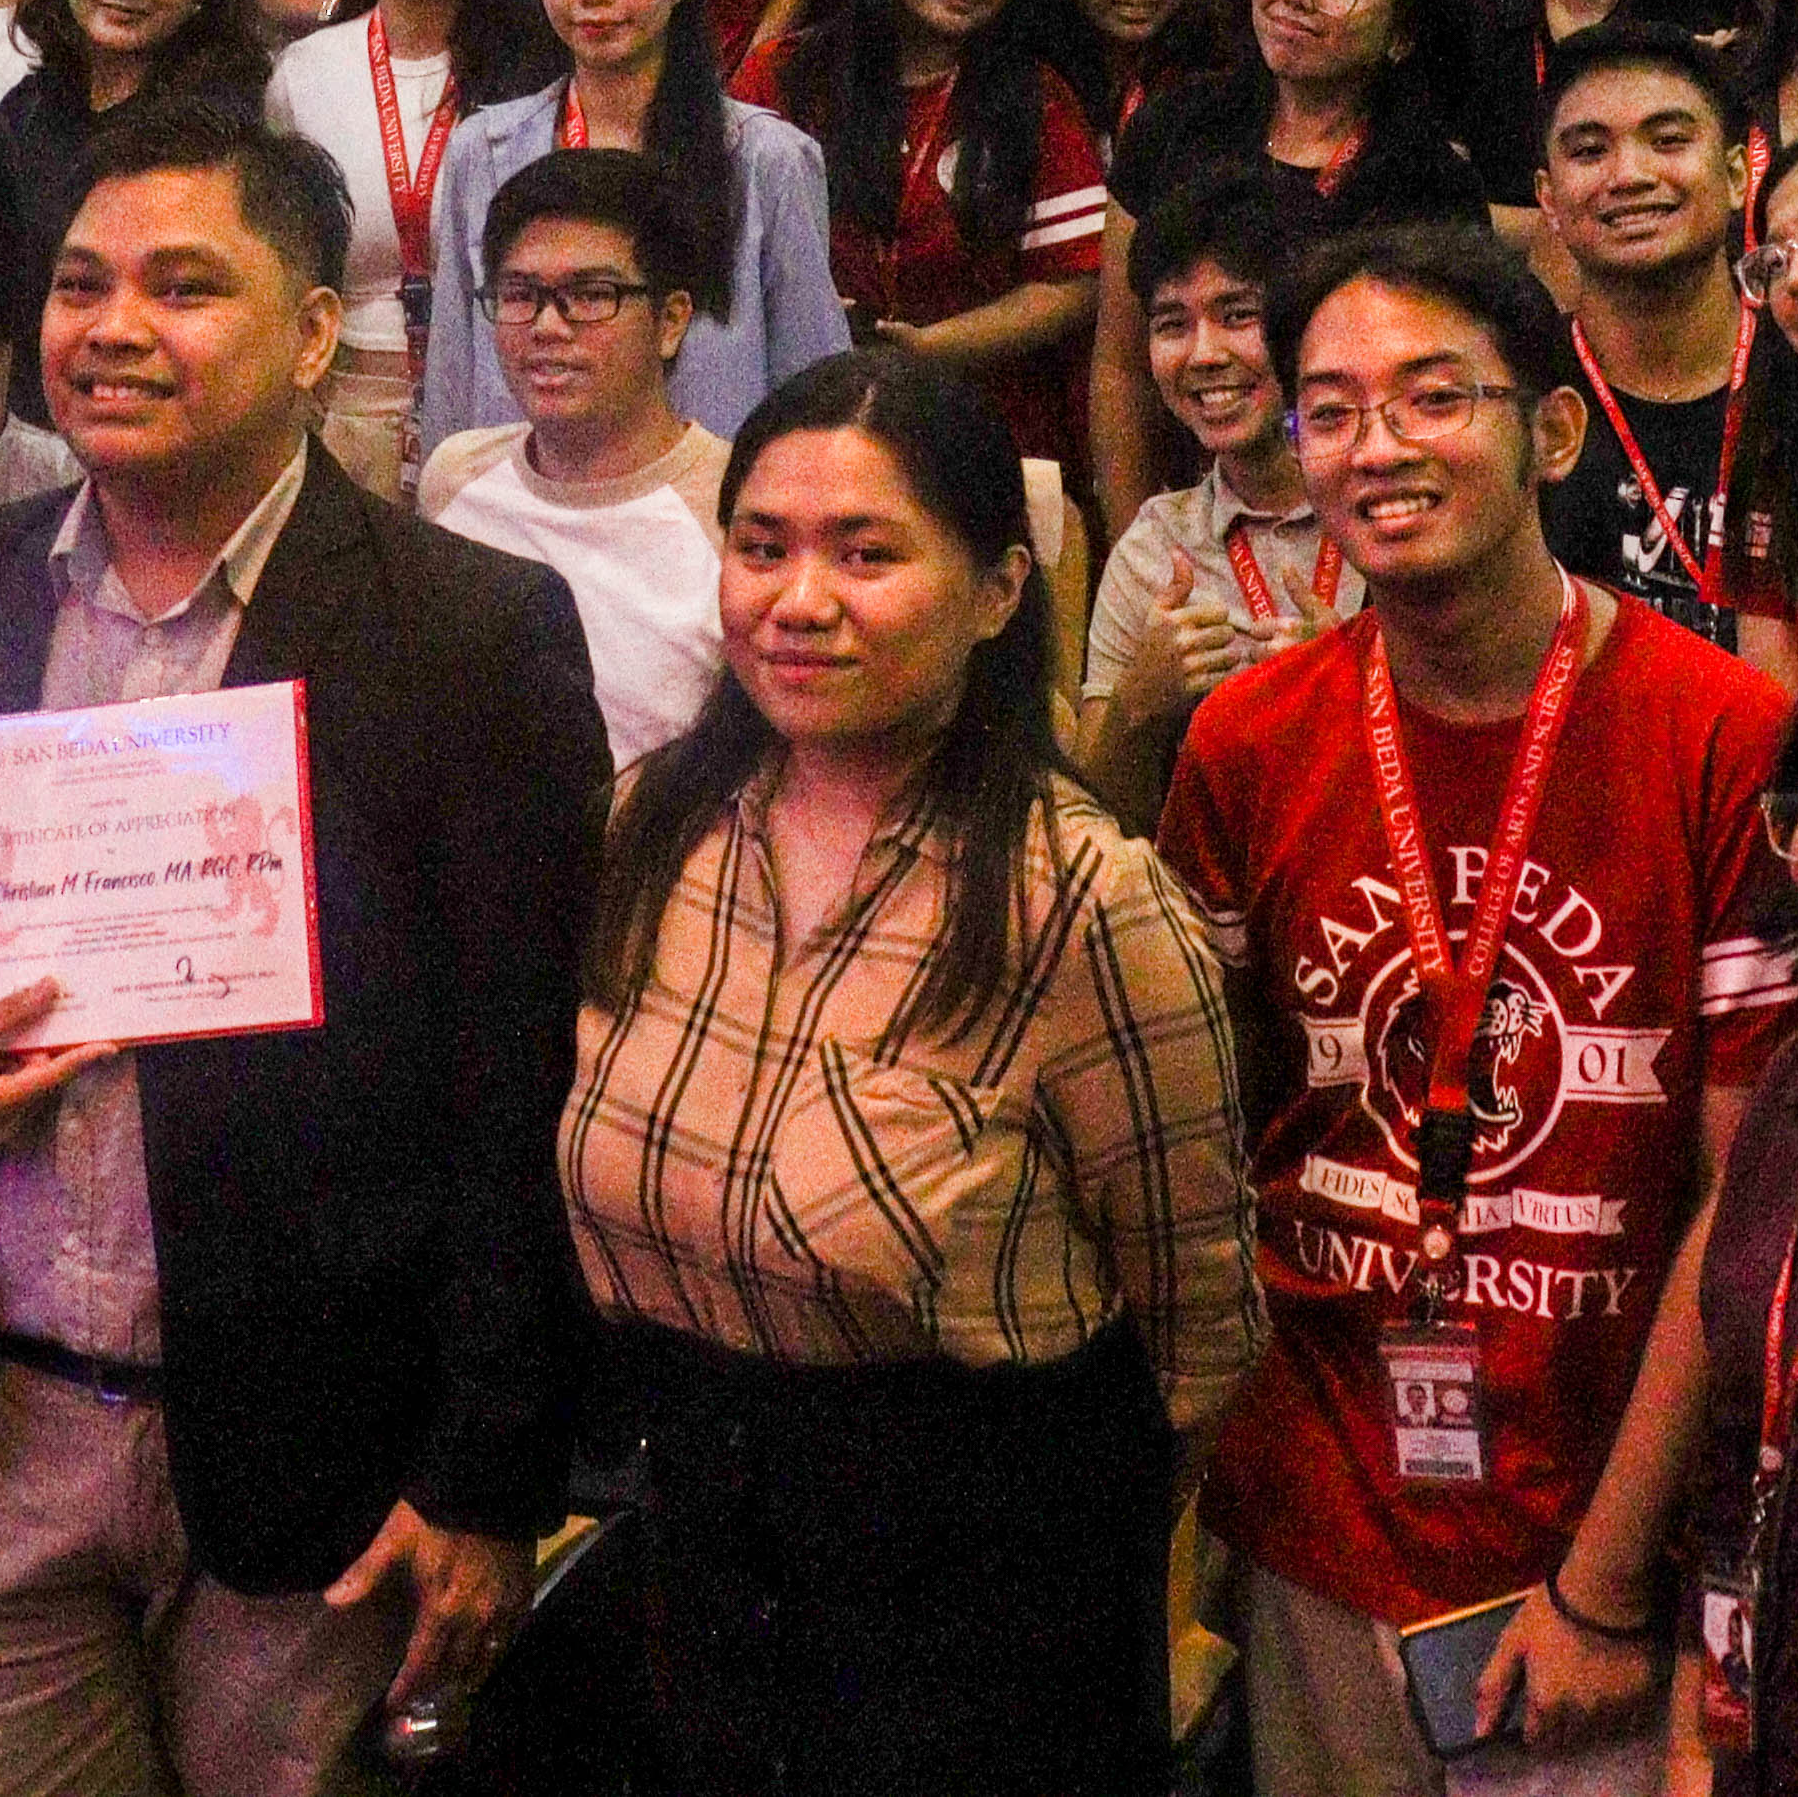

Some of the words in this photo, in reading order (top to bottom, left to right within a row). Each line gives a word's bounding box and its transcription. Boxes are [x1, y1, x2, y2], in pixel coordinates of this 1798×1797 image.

[370, 33, 383, 64] SAN
[375, 66, 391, 106] BEDA
[383, 107, 406, 193] UNIVERSITY
[1367, 665, 1390, 719] SAN
[1533, 645, 1574, 741] SCIENCES
[12, 748, 53, 766] SAN
[57, 739, 109, 760] BEDA
[111, 721, 231, 753] UNIVERSITY
[1372, 724, 1404, 801] BEDA
[1521, 749, 1544, 798] AND
[89, 820, 107, 837] OF
[115, 804, 237, 834] APPRECIATION
[1506, 798, 1530, 847] ARTS
[1389, 804, 1447, 974] UNIVERSITY
[1498, 852, 1515, 881] OF
[1467, 884, 1507, 977] COLLEGE
[1577, 1042, 1627, 1086] 01
[1321, 1167, 1381, 1199] FIDES
[1517, 1194, 1596, 1227] VIRTUS
[1295, 1220, 1637, 1321] UNIVRSITY
